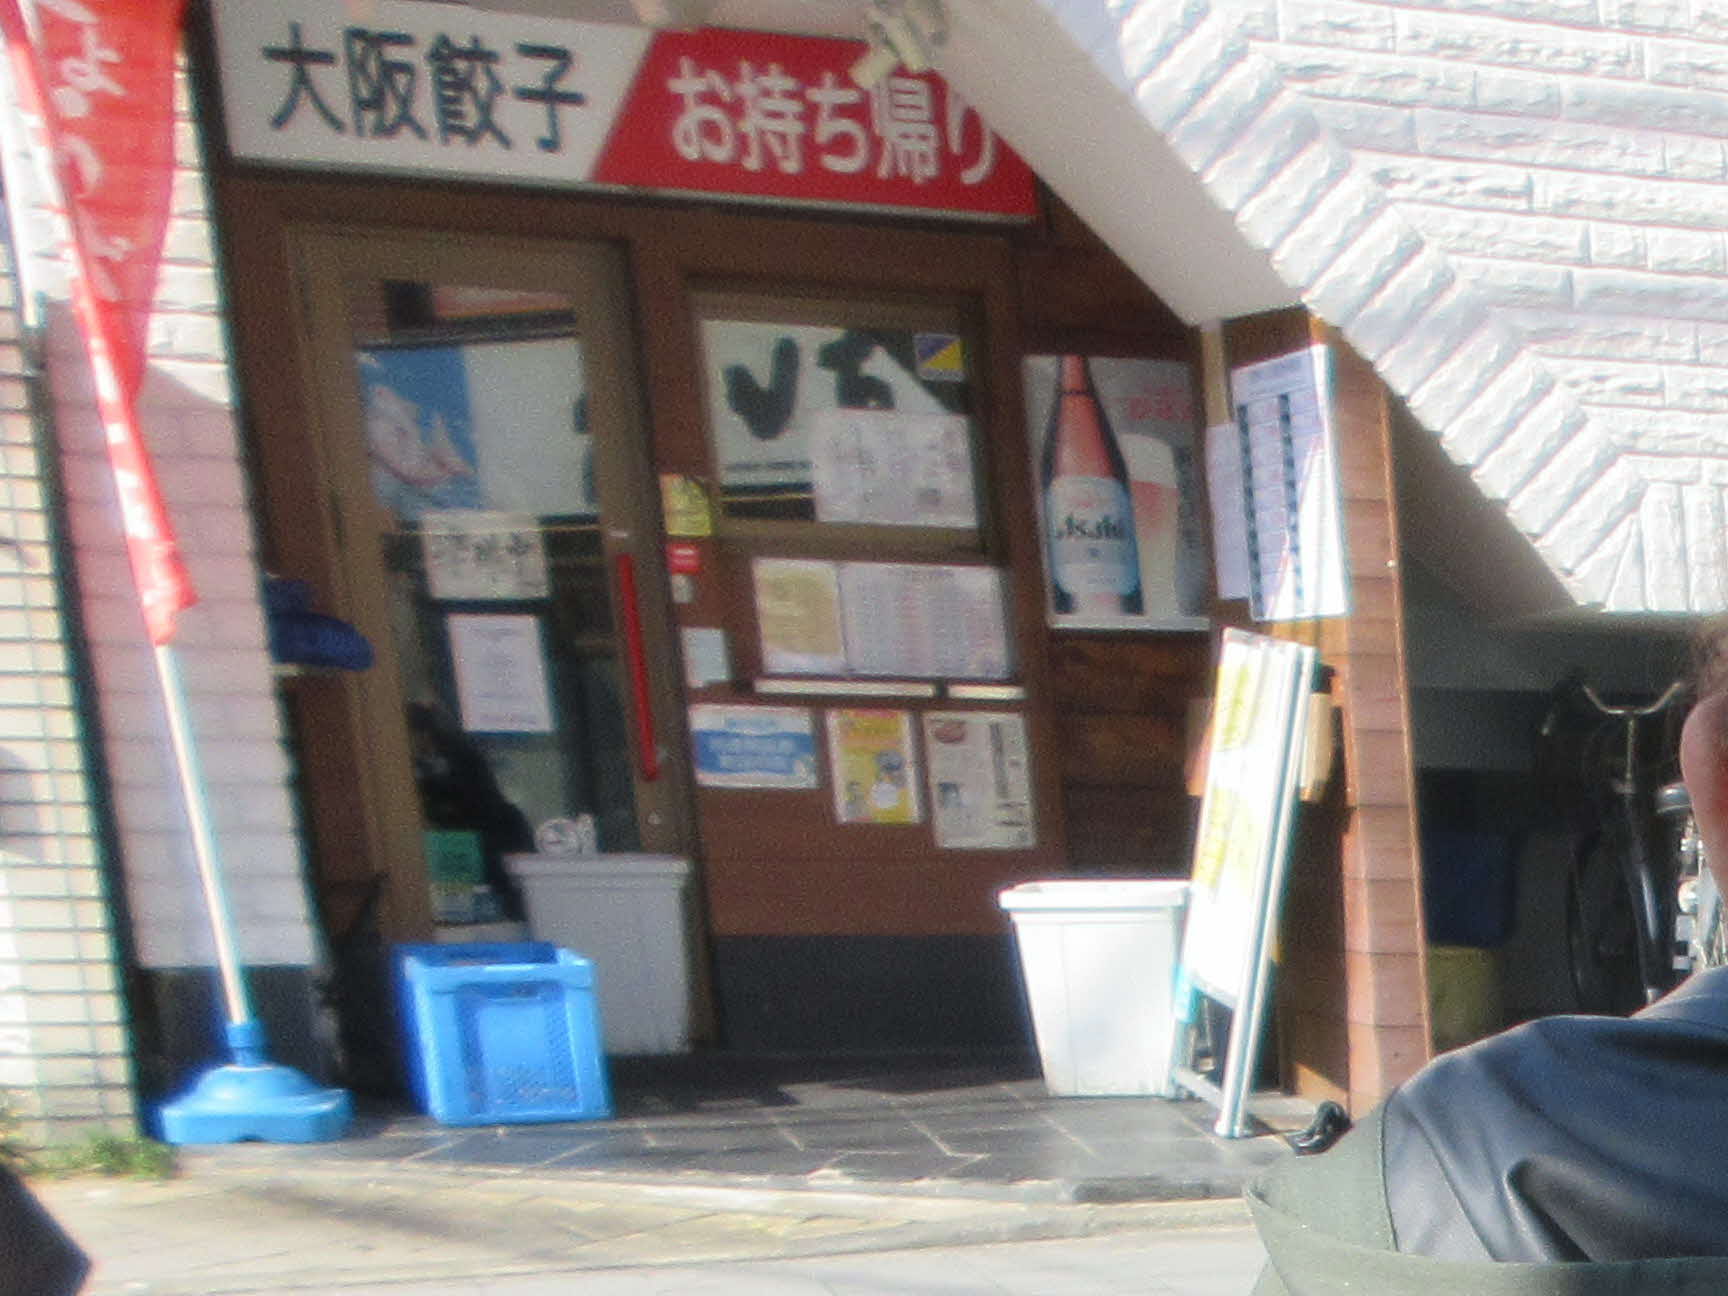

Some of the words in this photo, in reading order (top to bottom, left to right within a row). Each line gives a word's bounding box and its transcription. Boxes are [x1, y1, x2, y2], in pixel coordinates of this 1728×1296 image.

[262, 22, 586, 152] 大阪餃子
[666, 55, 997, 185] お持ち帰り
